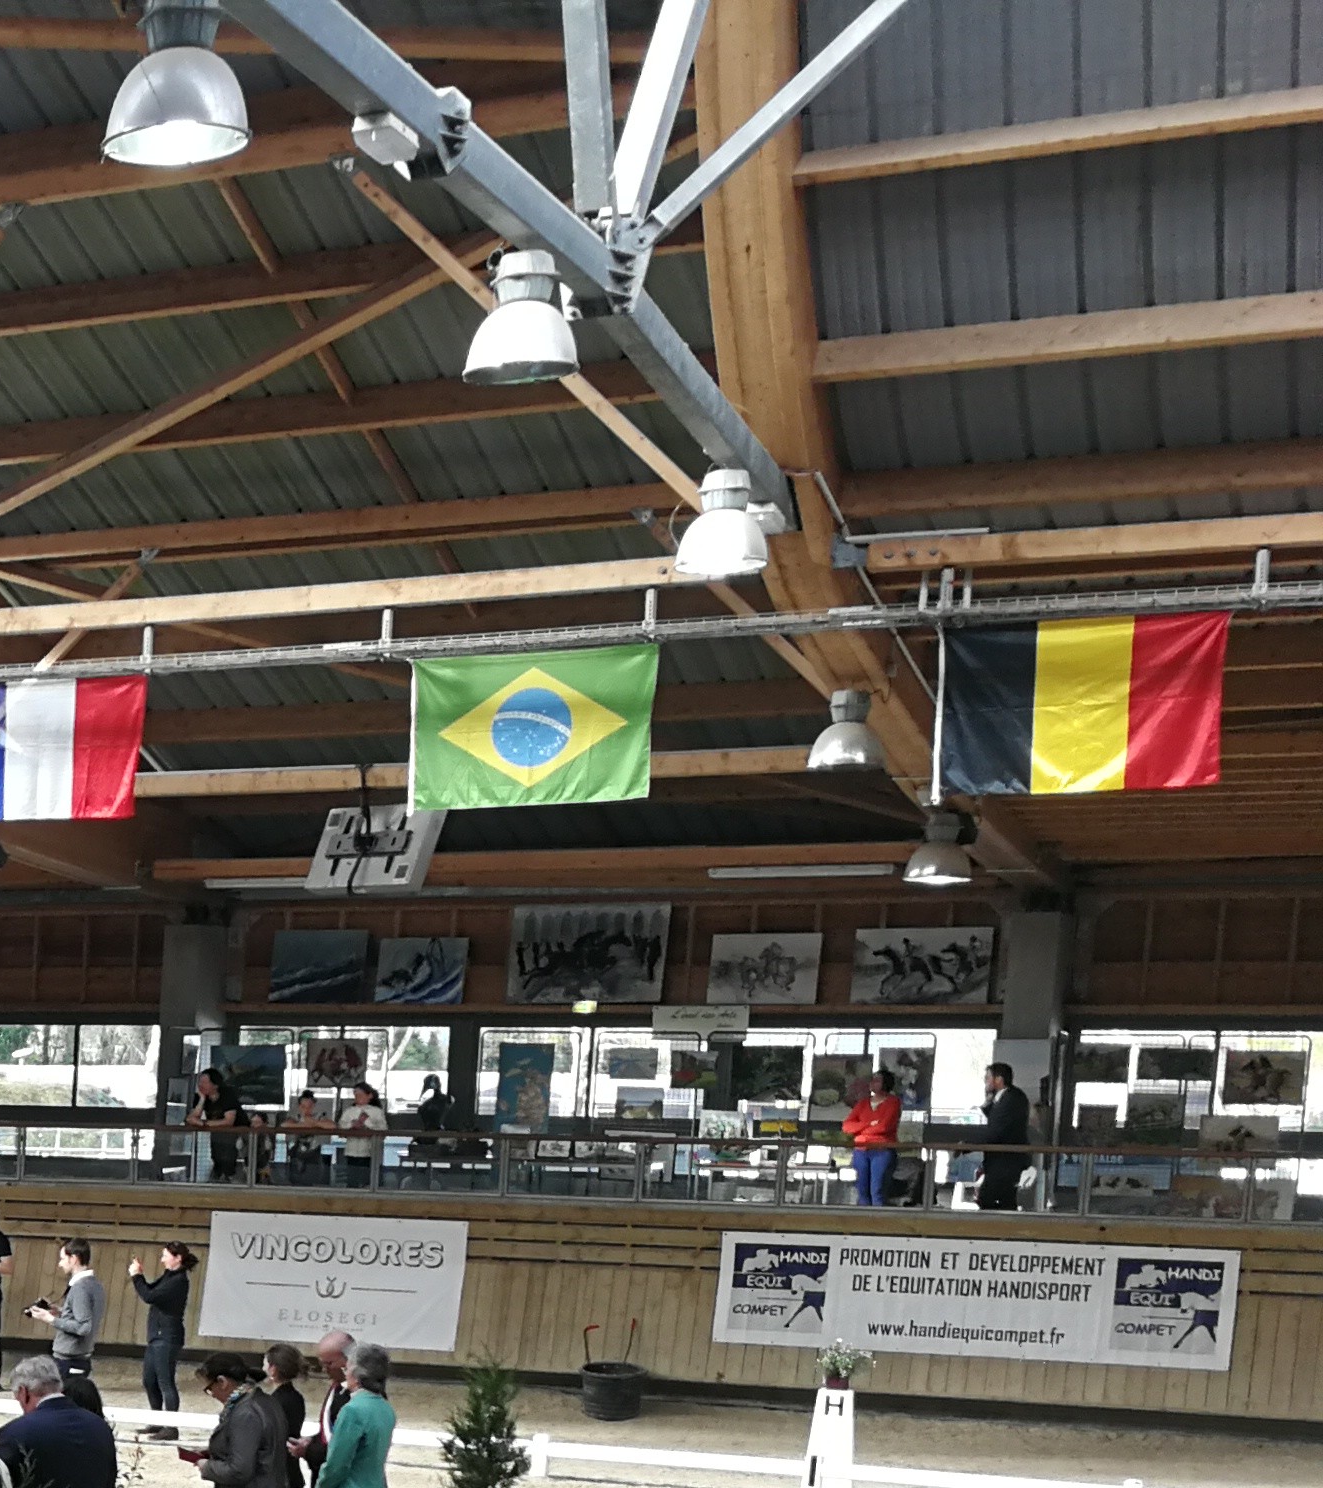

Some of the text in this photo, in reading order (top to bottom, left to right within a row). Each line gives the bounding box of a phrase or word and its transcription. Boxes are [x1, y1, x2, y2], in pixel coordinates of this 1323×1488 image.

[231, 1232, 445, 1269] VINCOLORES
[780, 1250, 828, 1265] HANDI
[839, 1248, 1106, 1276] PROMOTION ET DEVELOPPEMENT
[746, 1275, 786, 1289] EQUI
[1167, 1267, 1221, 1282] HANDI
[852, 1274, 1092, 1302] DE L'EQUITATION HANDISPORT
[1129, 1291, 1176, 1306] EQUI
[277, 1308, 378, 1326] ELOSEGI
[732, 1303, 788, 1316] COMPET
[868, 1320, 1065, 1348] www.handiequicompet.fr
[1114, 1322, 1177, 1336] COMPET
[825, 1395, 844, 1416] H
